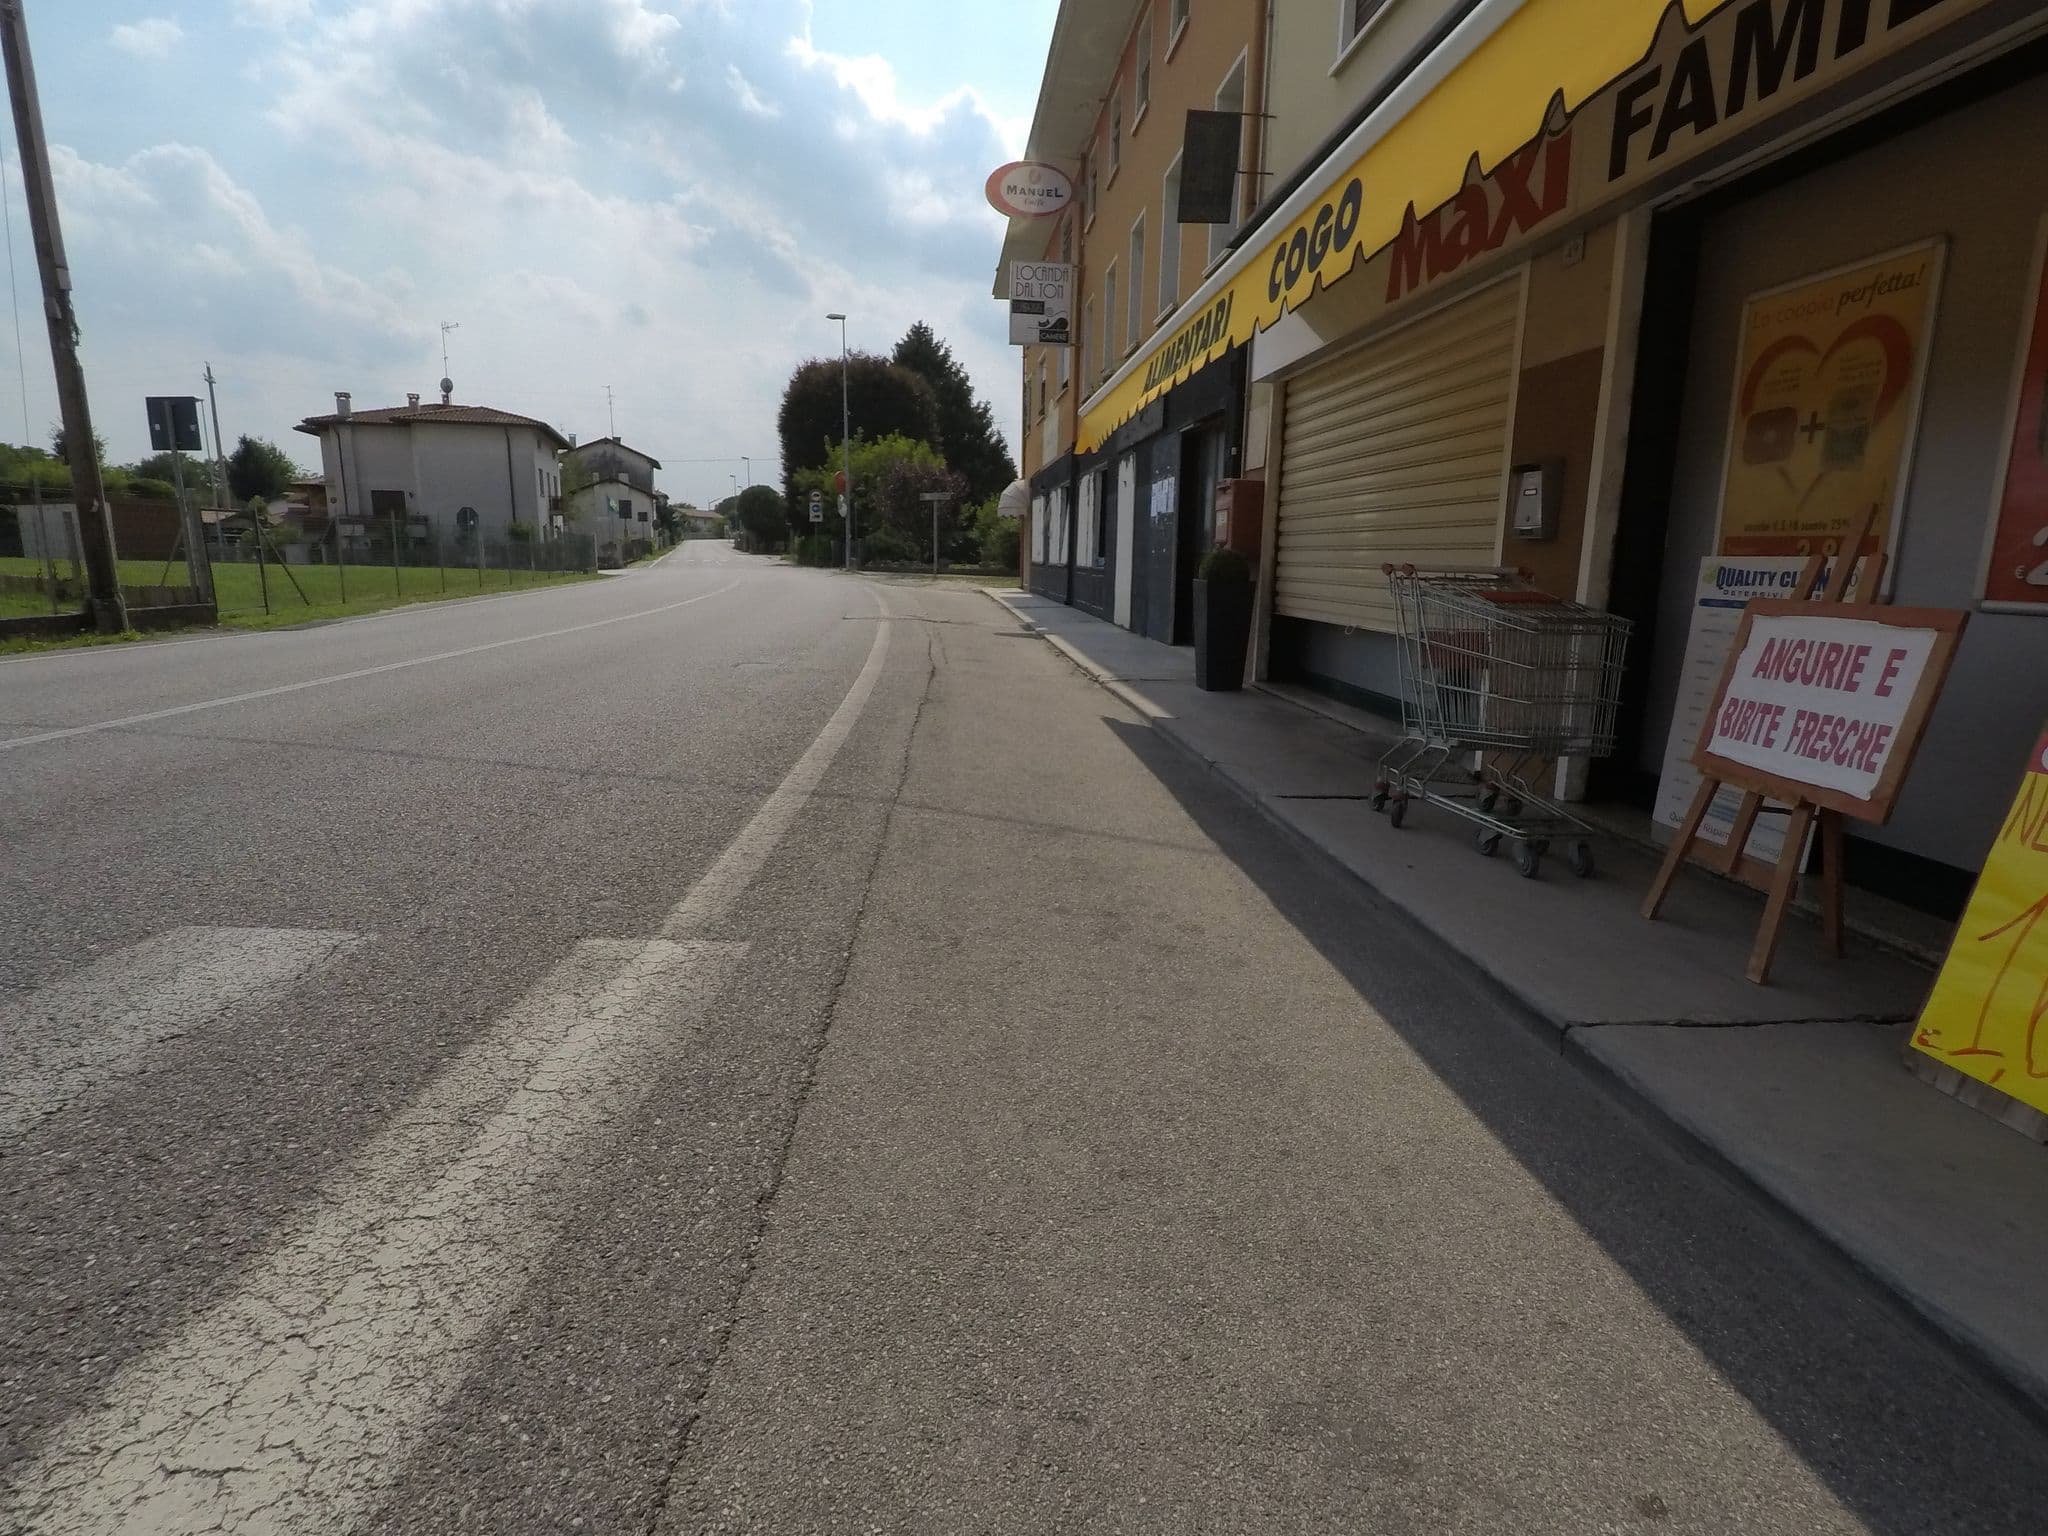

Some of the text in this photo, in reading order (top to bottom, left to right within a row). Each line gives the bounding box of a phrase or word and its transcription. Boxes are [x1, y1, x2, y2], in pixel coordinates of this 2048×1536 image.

[1608, 0, 1942, 182] FAMI
[1006, 185, 1064, 198] MANUEL
[1015, 265, 1069, 282] LOCANDA
[1015, 282, 1035, 298] DAL
[1140, 178, 1363, 397] ALIMENTARI COGO
[1836, 263, 1926, 316] perfetta!
[1716, 566, 1778, 590] QUALITY
[1752, 637, 1907, 697] ANGURIE E
[1718, 697, 1893, 774] BIBITE FRESCHE
